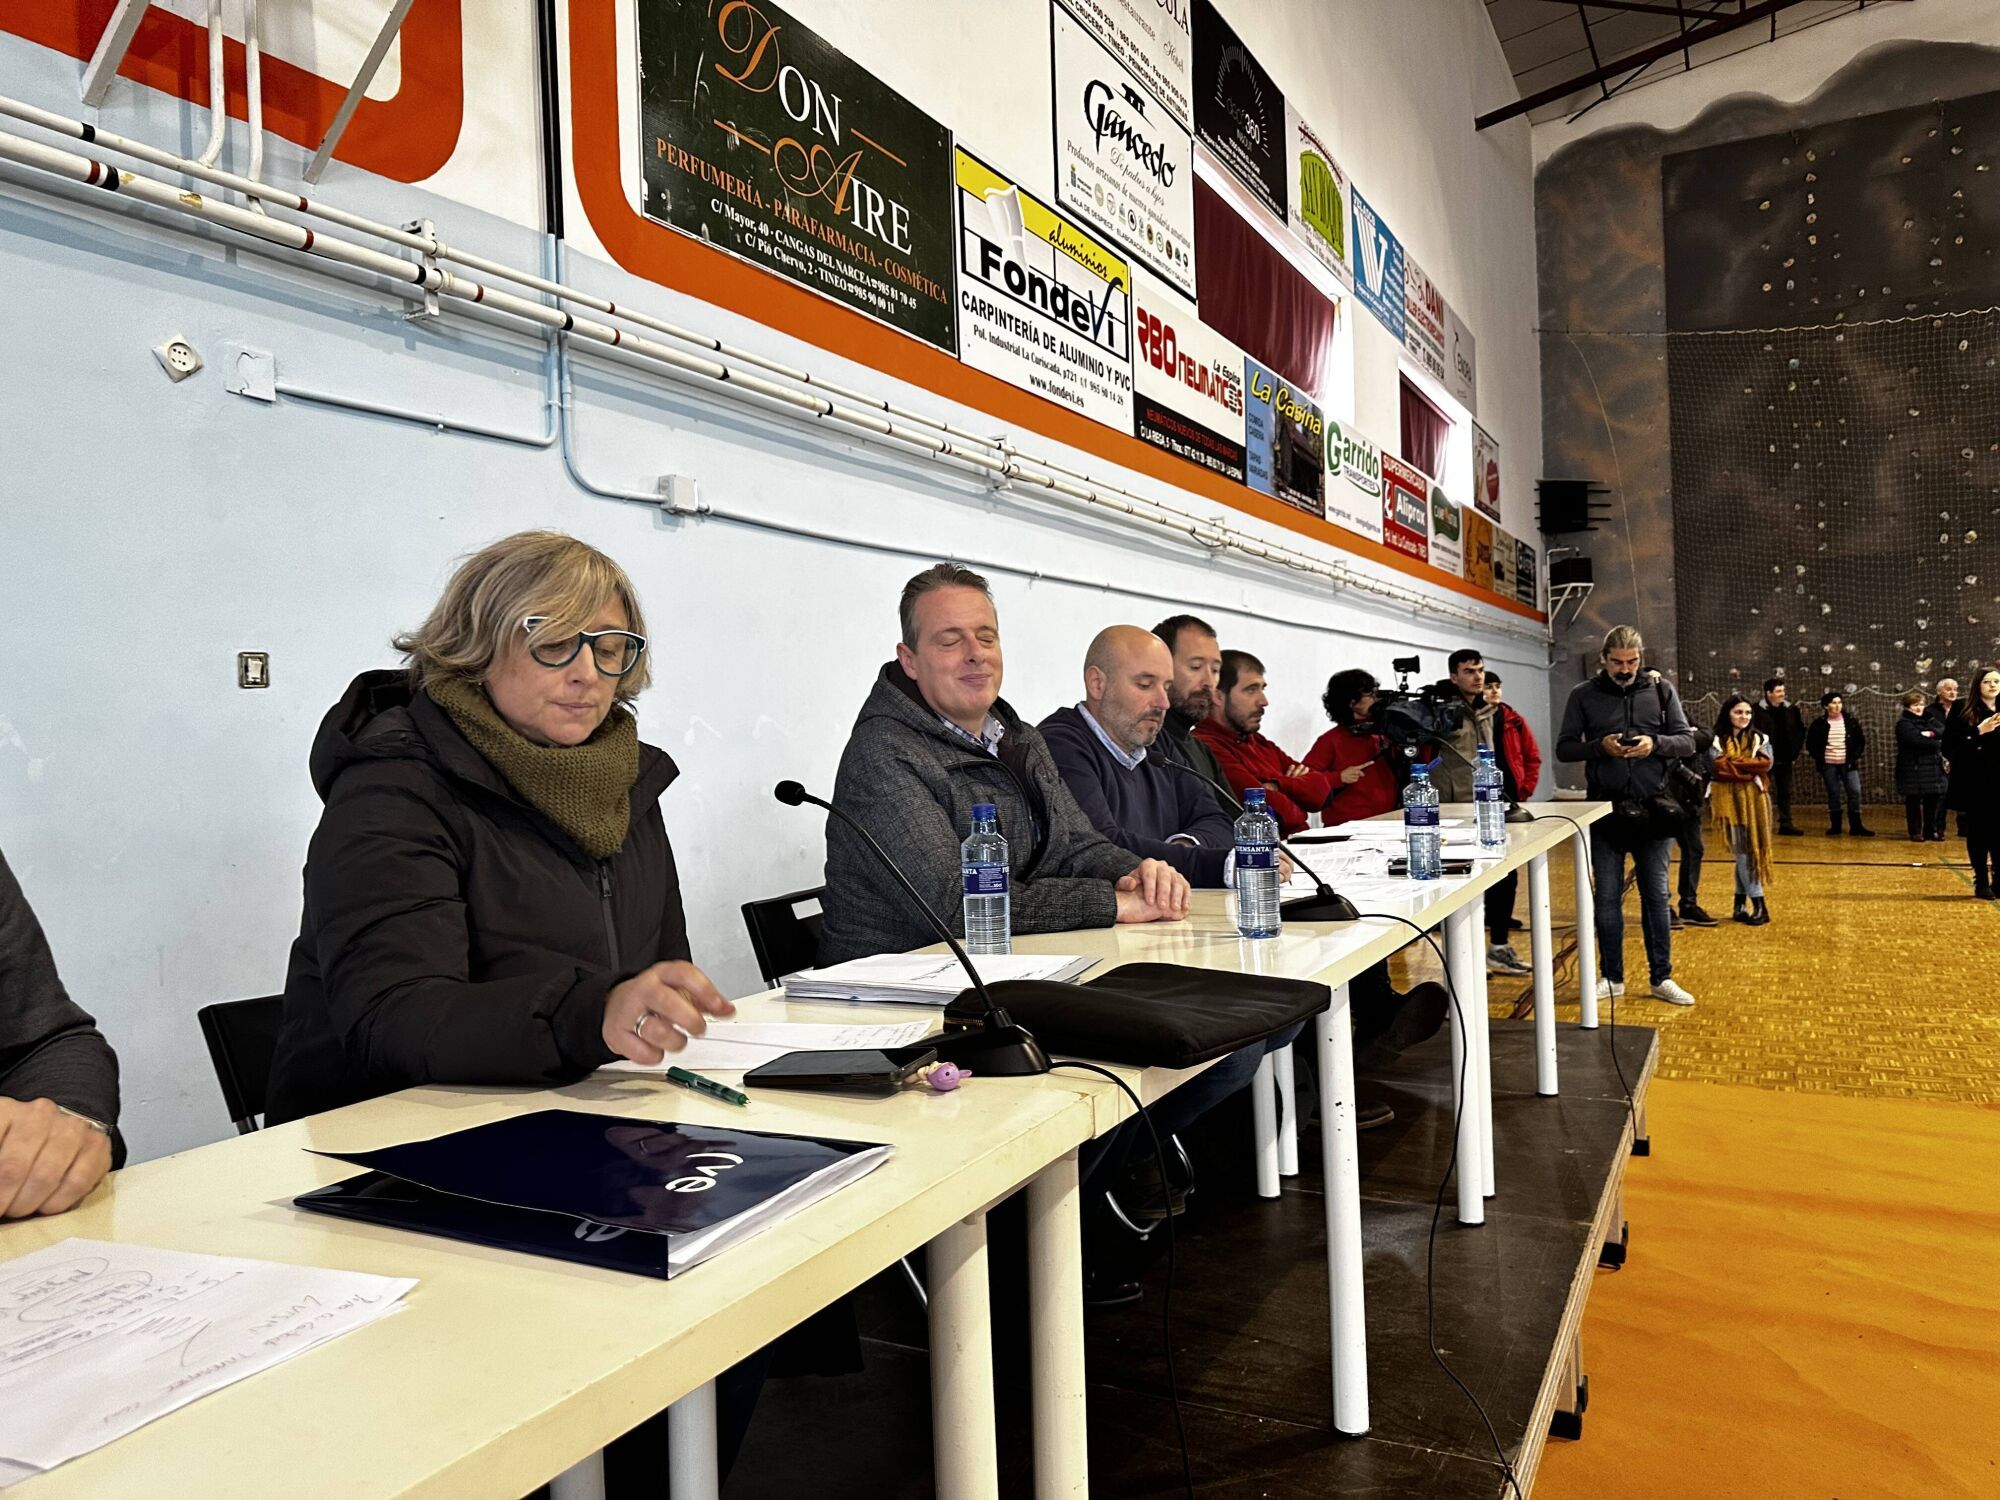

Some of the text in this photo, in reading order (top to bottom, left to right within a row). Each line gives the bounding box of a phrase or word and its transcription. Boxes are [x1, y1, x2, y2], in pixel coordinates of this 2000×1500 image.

[708, 0, 842, 146] DON
[1107, 33, 1125, 56] TINEO
[1084, 79, 1176, 189] Gancedo
[1067, 139, 1095, 171] Productos
[1095, 164, 1121, 192] artesanos
[656, 137, 763, 209] PERFUMERÍA
[774, 198, 877, 268] PARAFARMACIA
[884, 257, 948, 304] COSMÉTICA
[774, 137, 912, 255] AIRE
[1070, 193, 1083, 209] SALA
[711, 198, 724, 214] C/
[724, 203, 757, 234] Mayor,
[758, 220, 769, 236] 40
[774, 229, 816, 261] CANGAS
[817, 250, 835, 270] DEL
[835, 260, 872, 288] NARCEA
[744, 232, 756, 248] C/
[807, 262, 814, 276] 2
[818, 266, 848, 291] TINEO
[887, 301, 895, 315] 11
[961, 290, 1131, 391] CARPINTERÍA DE ALUMINIO Y PVC
[989, 331, 1021, 356] Industrial
[1213, 359, 1241, 386] La Espina
[1250, 370, 1272, 404] La
[1327, 421, 1379, 480] Garrido
[1396, 492, 1426, 527] Aliprox
